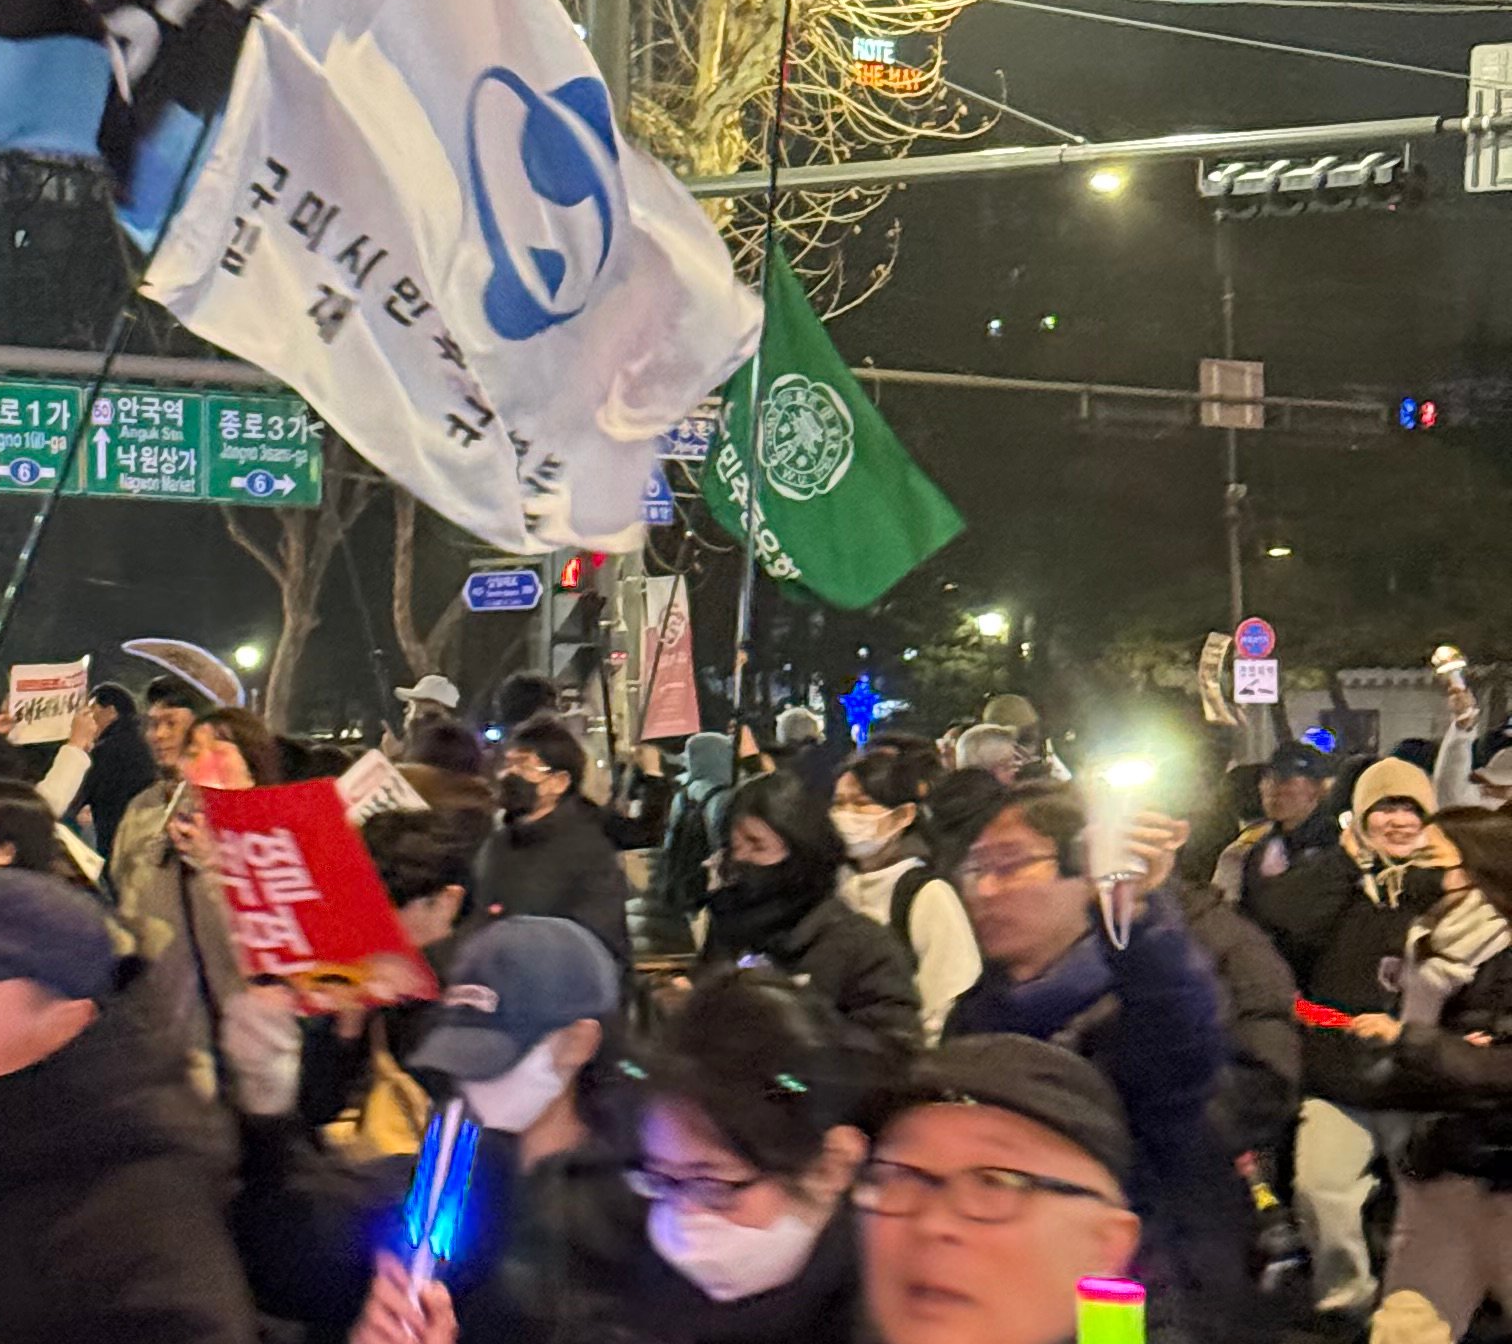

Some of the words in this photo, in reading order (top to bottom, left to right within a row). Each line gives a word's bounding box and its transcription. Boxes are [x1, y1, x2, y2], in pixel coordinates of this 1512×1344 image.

[117, 396, 183, 428] 안국역
[219, 409, 308, 444] 종로3가
[17, 462, 32, 482] 6
[117, 444, 197, 475] 낙원상가
[253, 474, 267, 494] 6
